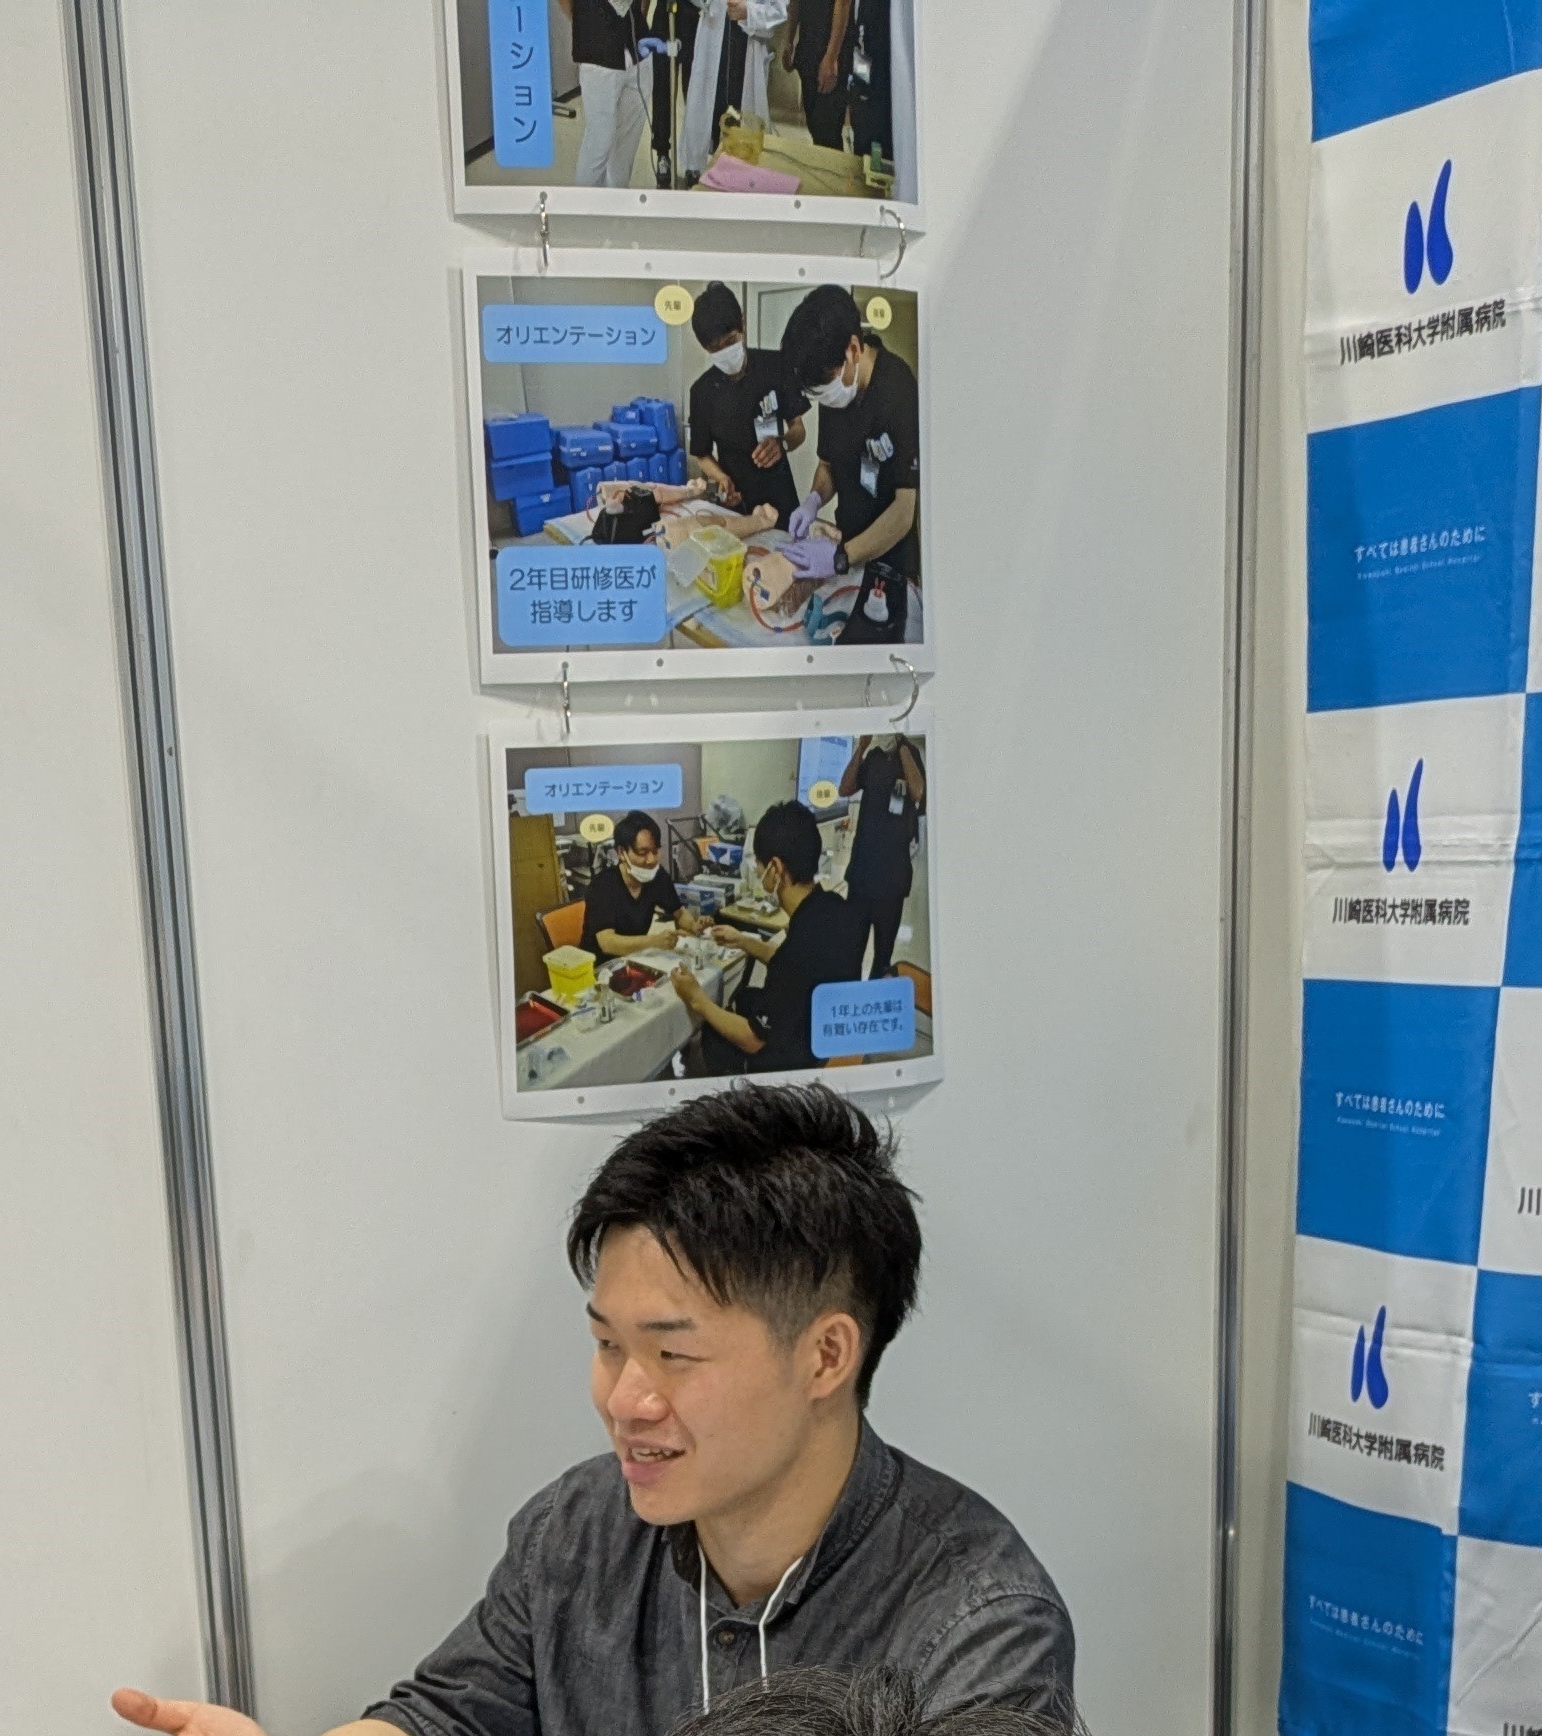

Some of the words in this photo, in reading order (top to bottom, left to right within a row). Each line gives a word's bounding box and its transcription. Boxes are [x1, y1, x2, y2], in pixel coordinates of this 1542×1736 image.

[496, 325, 656, 346] オリエンテーション
[1340, 297, 1506, 366] 川崎医科大学附属病院
[509, 564, 657, 592] 2年目研修医が
[531, 598, 638, 624] 指導します
[545, 780, 664, 798] オリエンテーション
[1332, 897, 1470, 926] 川崎医科大学附属病院
[1308, 1412, 1445, 1472] 川崎医科大学附属病院
